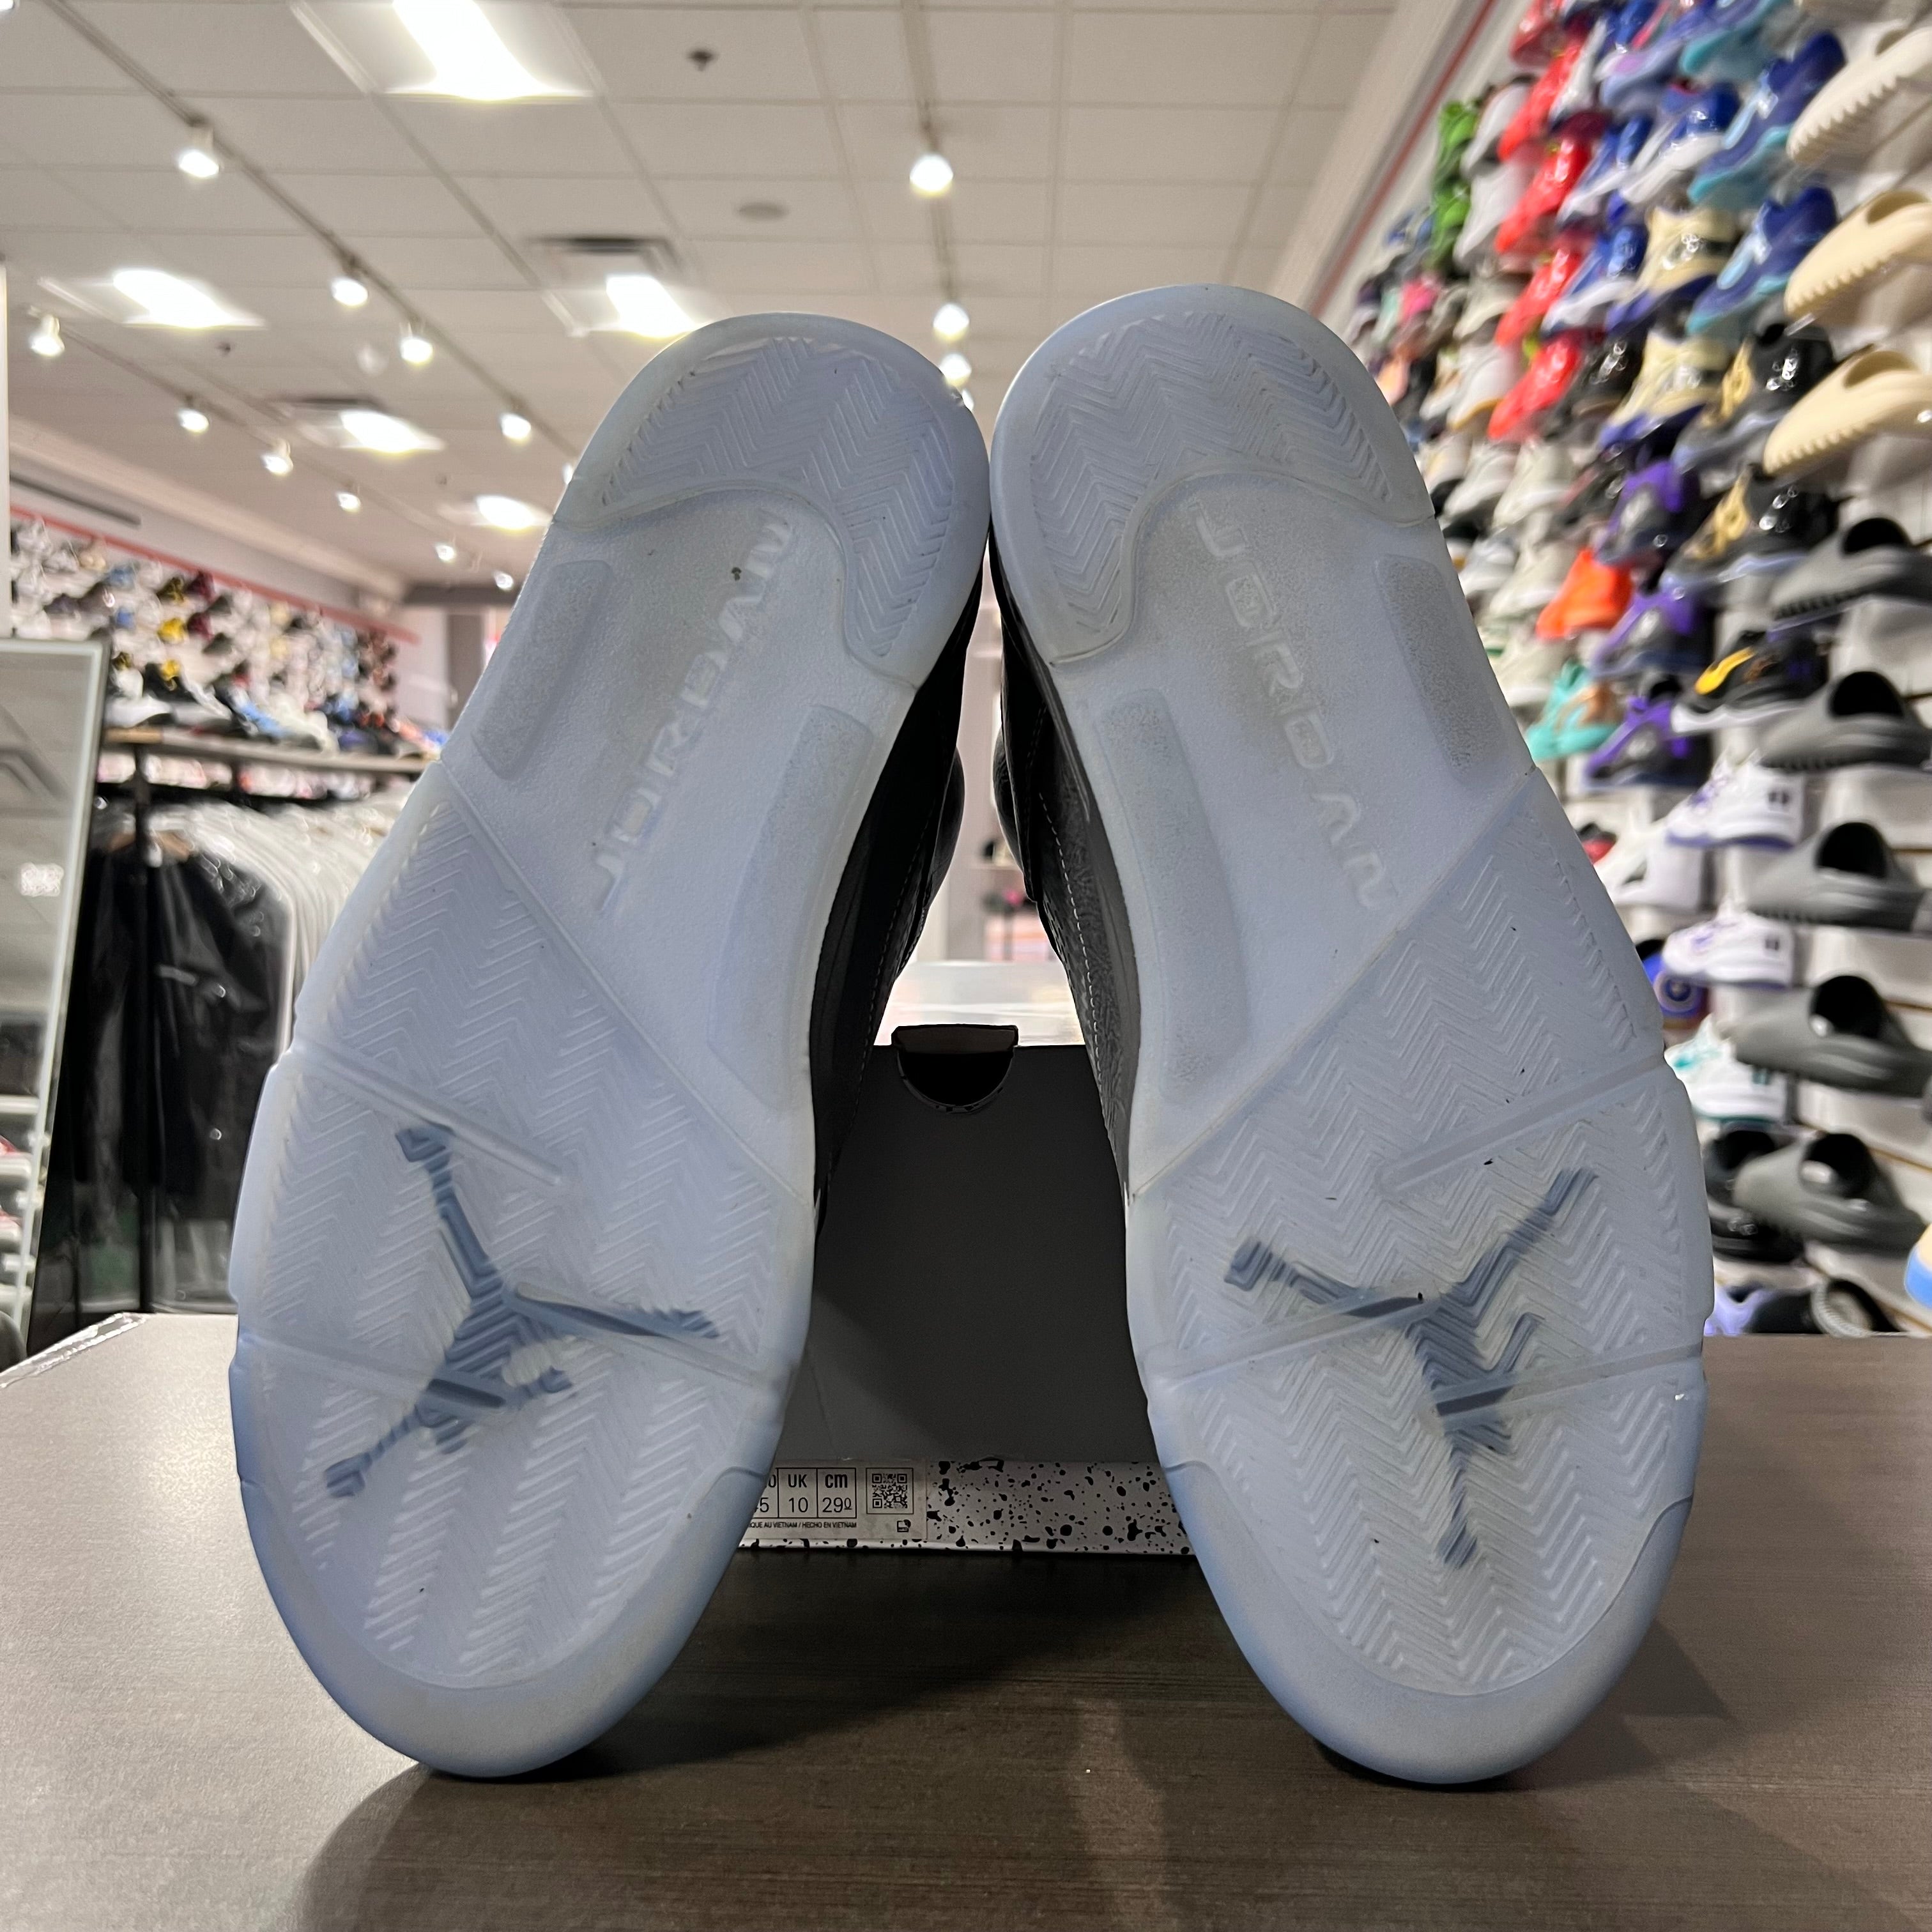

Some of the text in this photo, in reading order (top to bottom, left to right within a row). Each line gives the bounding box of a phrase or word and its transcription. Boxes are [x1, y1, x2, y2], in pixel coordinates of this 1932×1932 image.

[593, 510, 792, 912] JORDAN
[1188, 502, 1398, 910] JORDAN
[754, 1497, 769, 1513] 5
[788, 1497, 808, 1513] 10
[788, 1474, 807, 1488] UK
[825, 1473, 848, 1488] cm
